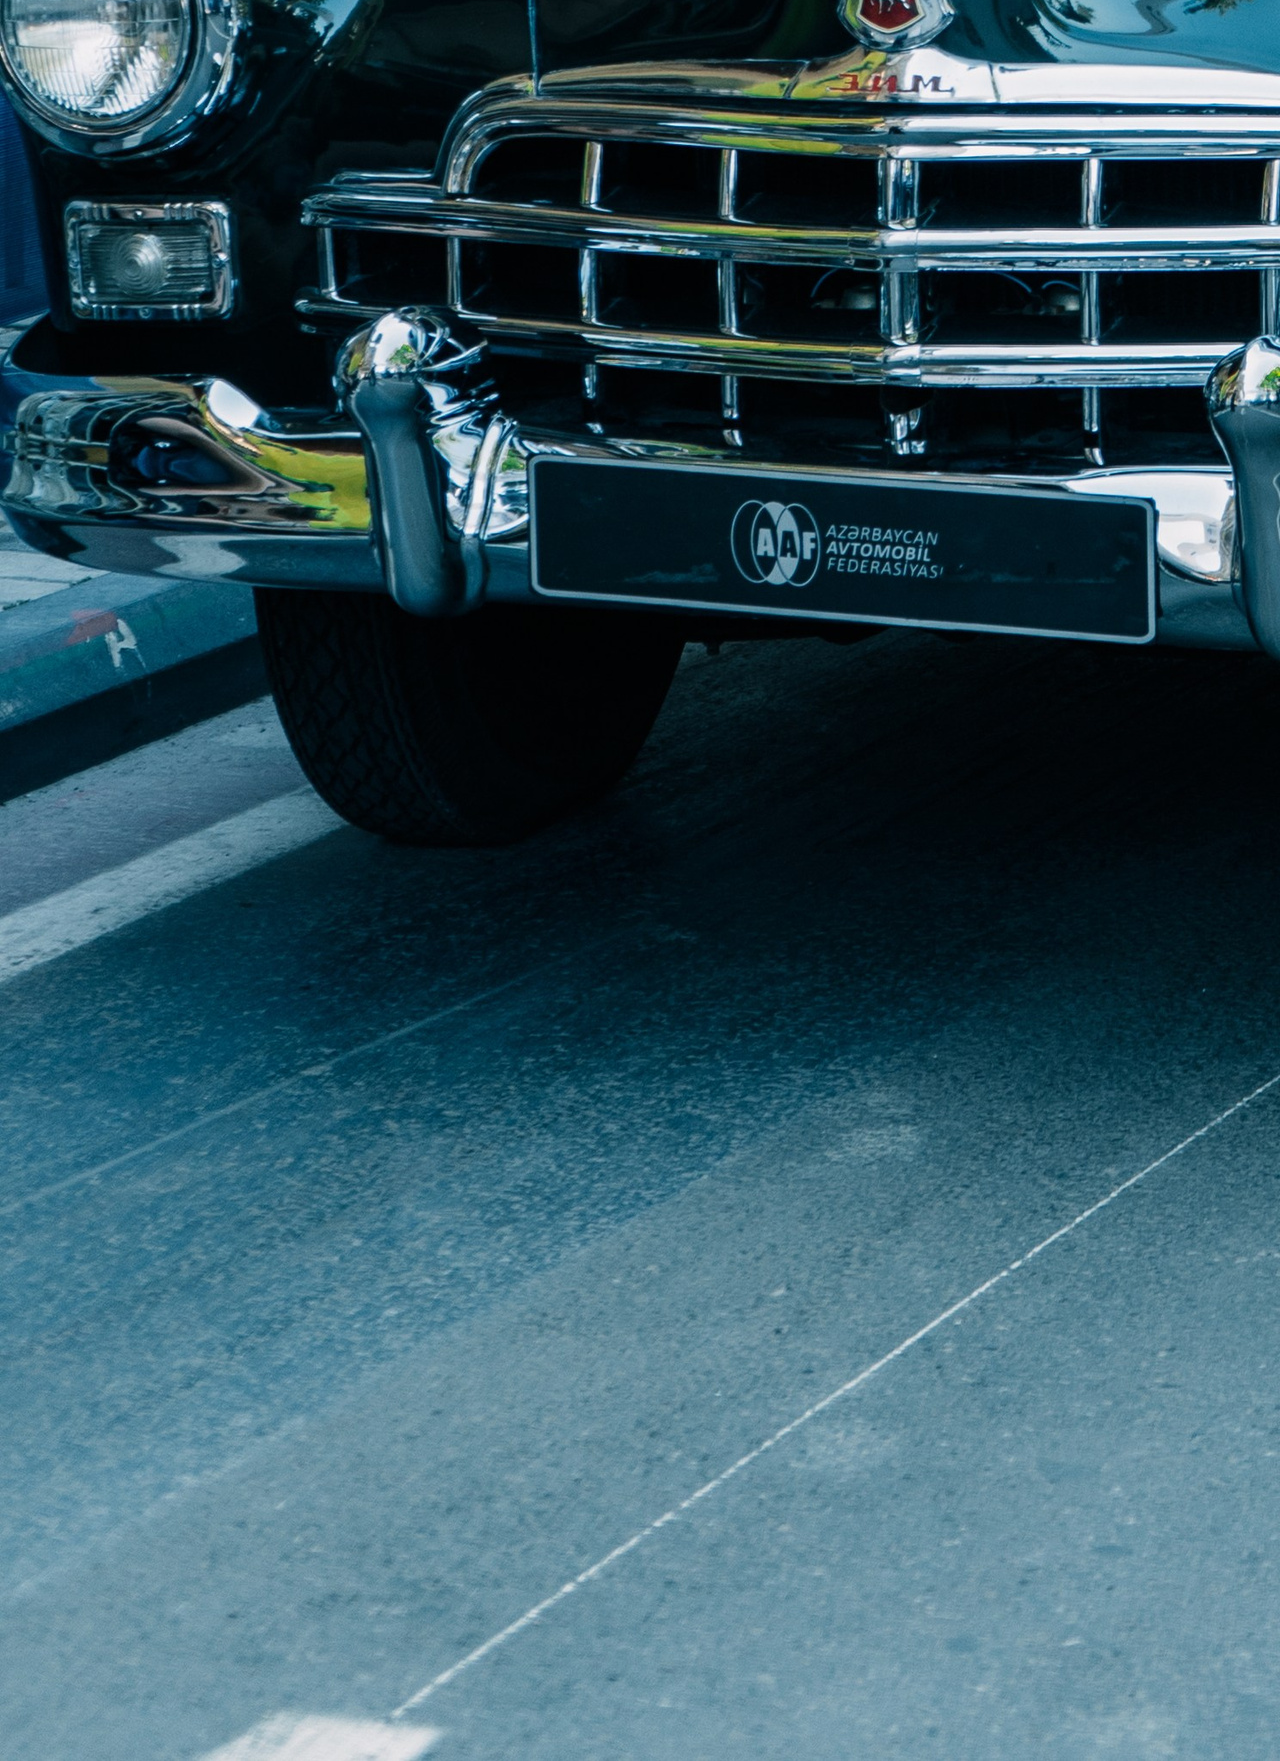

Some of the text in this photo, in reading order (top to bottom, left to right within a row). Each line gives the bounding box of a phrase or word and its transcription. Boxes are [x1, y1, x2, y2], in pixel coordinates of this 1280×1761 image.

[756, 528, 817, 560] AAF
[825, 524, 939, 546] AZƏRBAYCAN
[825, 541, 932, 563] AVTOMOBİL
